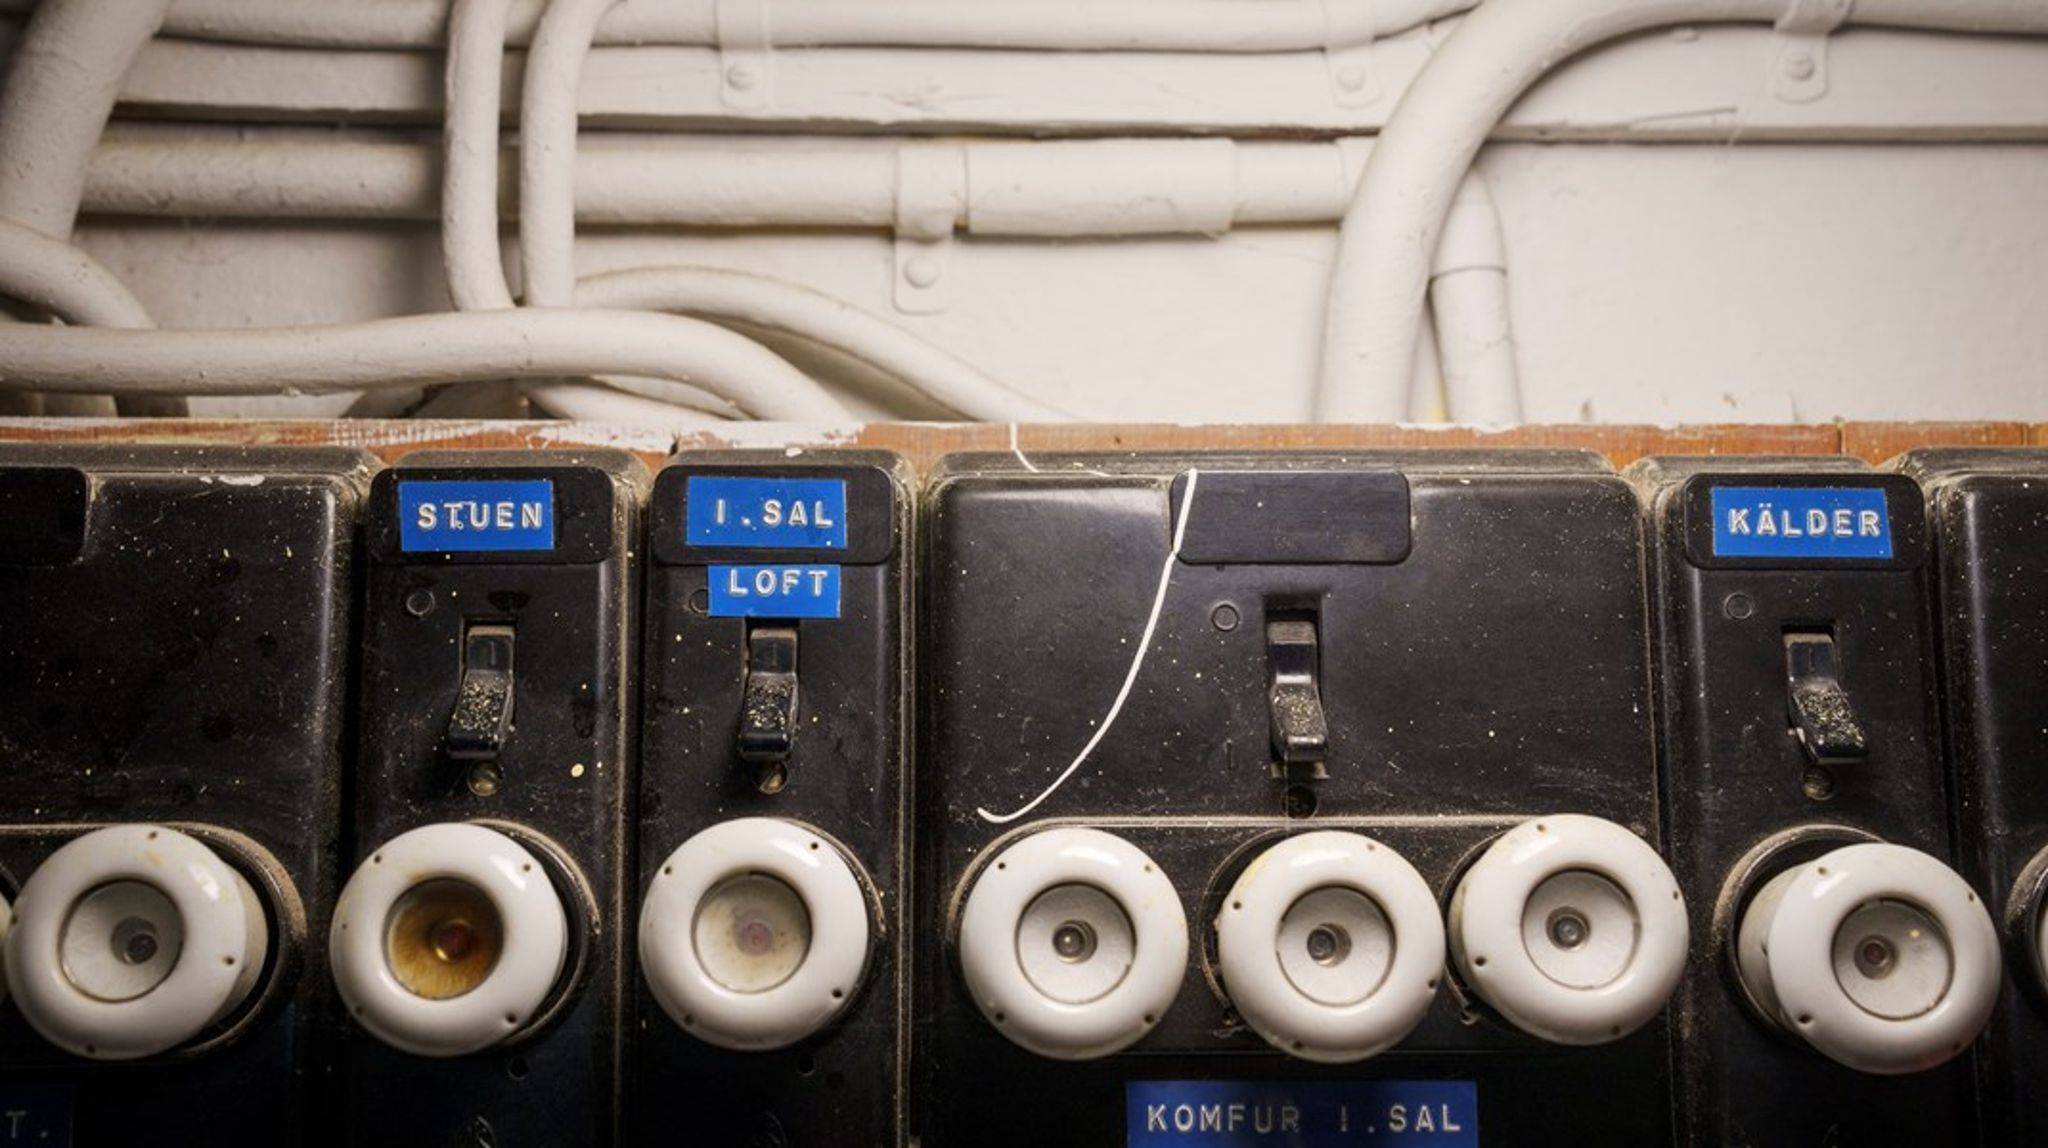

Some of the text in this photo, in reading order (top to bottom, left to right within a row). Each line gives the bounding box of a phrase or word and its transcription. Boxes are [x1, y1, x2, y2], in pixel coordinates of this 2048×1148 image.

[417, 501, 542, 530] STUEN
[1728, 503, 1881, 537] KÄLDER
[728, 568, 829, 598] LOFT
[1146, 1103, 1301, 1133] KOMFUR
